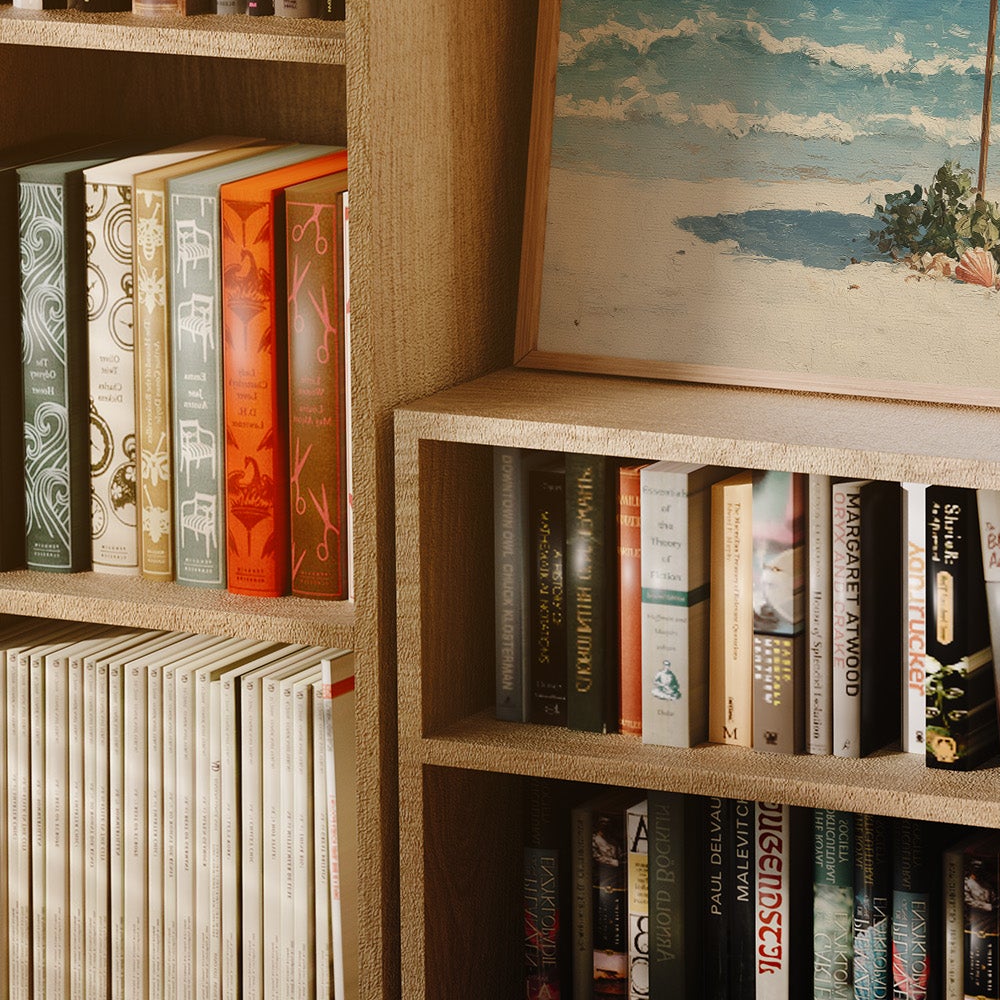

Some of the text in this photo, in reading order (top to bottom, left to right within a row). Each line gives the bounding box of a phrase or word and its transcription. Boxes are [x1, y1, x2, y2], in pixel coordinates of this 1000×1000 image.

[834, 493, 845, 669] ORYX AND CRAKE
[846, 493, 859, 698] MARGARET ATWOOD
[710, 797, 722, 915] PAUL DELVAU
